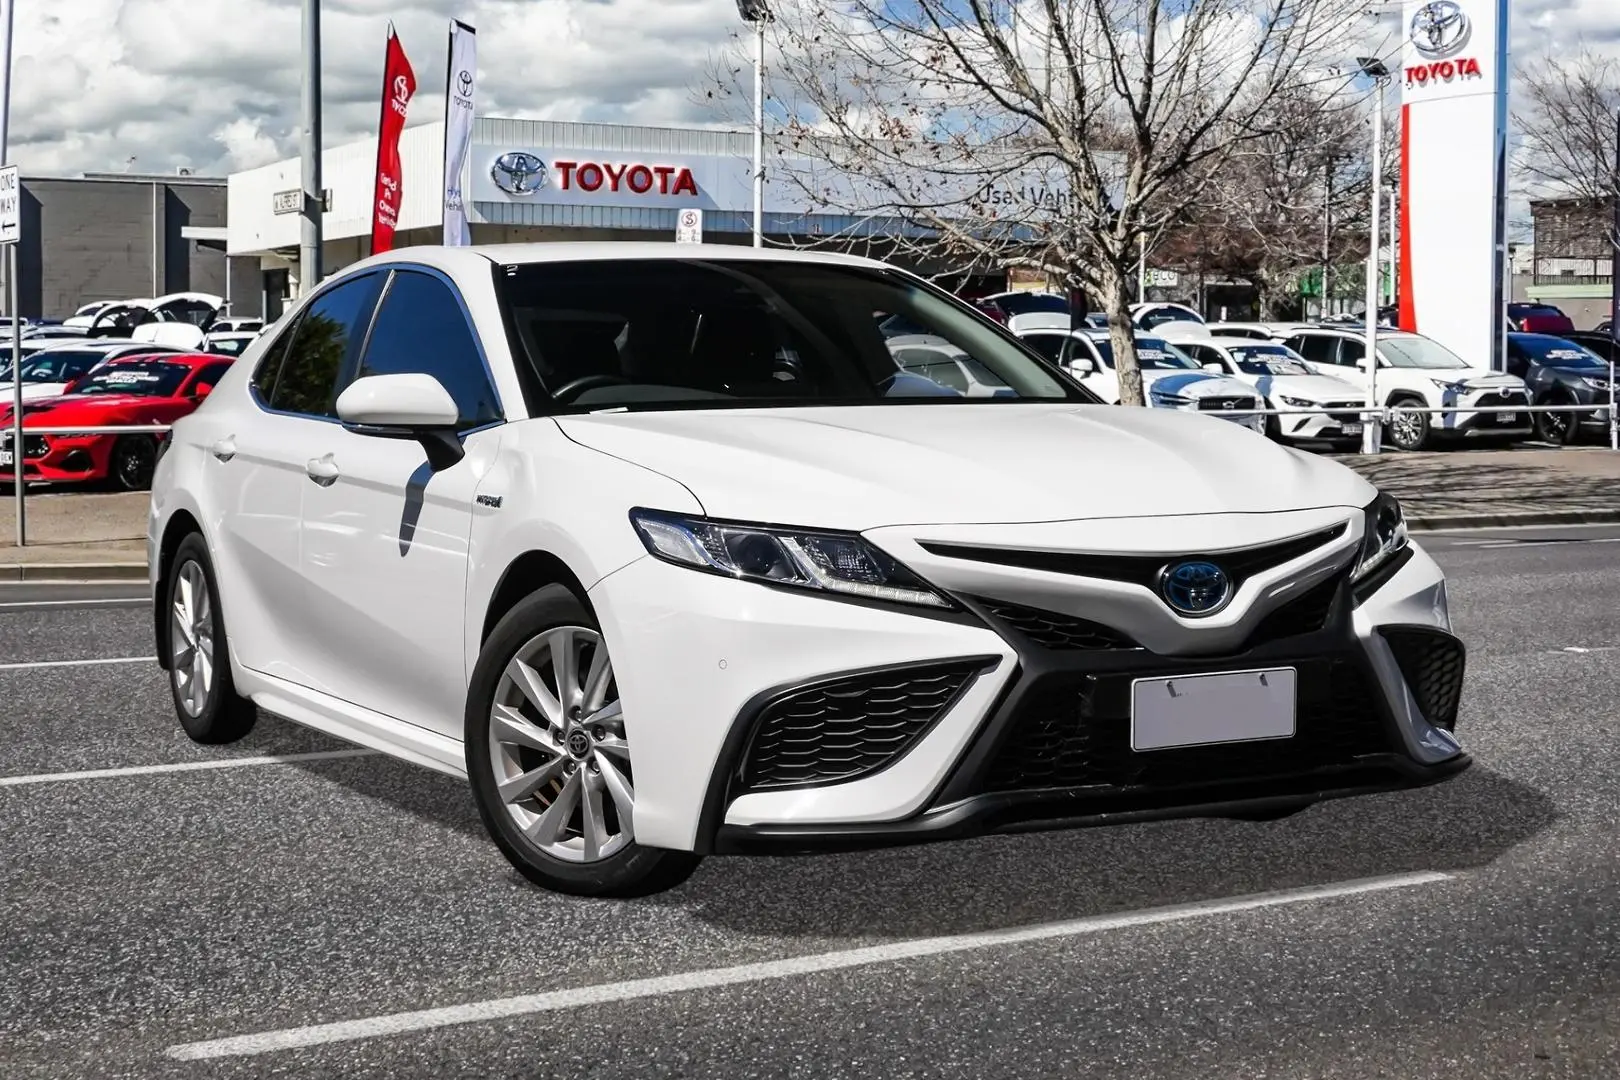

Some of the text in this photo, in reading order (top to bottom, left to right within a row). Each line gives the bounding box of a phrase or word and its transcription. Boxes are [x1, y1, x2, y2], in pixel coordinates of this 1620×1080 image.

[1404, 58, 1481, 83] TOYOTA
[1, 173, 15, 191] ONE
[555, 161, 698, 196] TOYOTA
